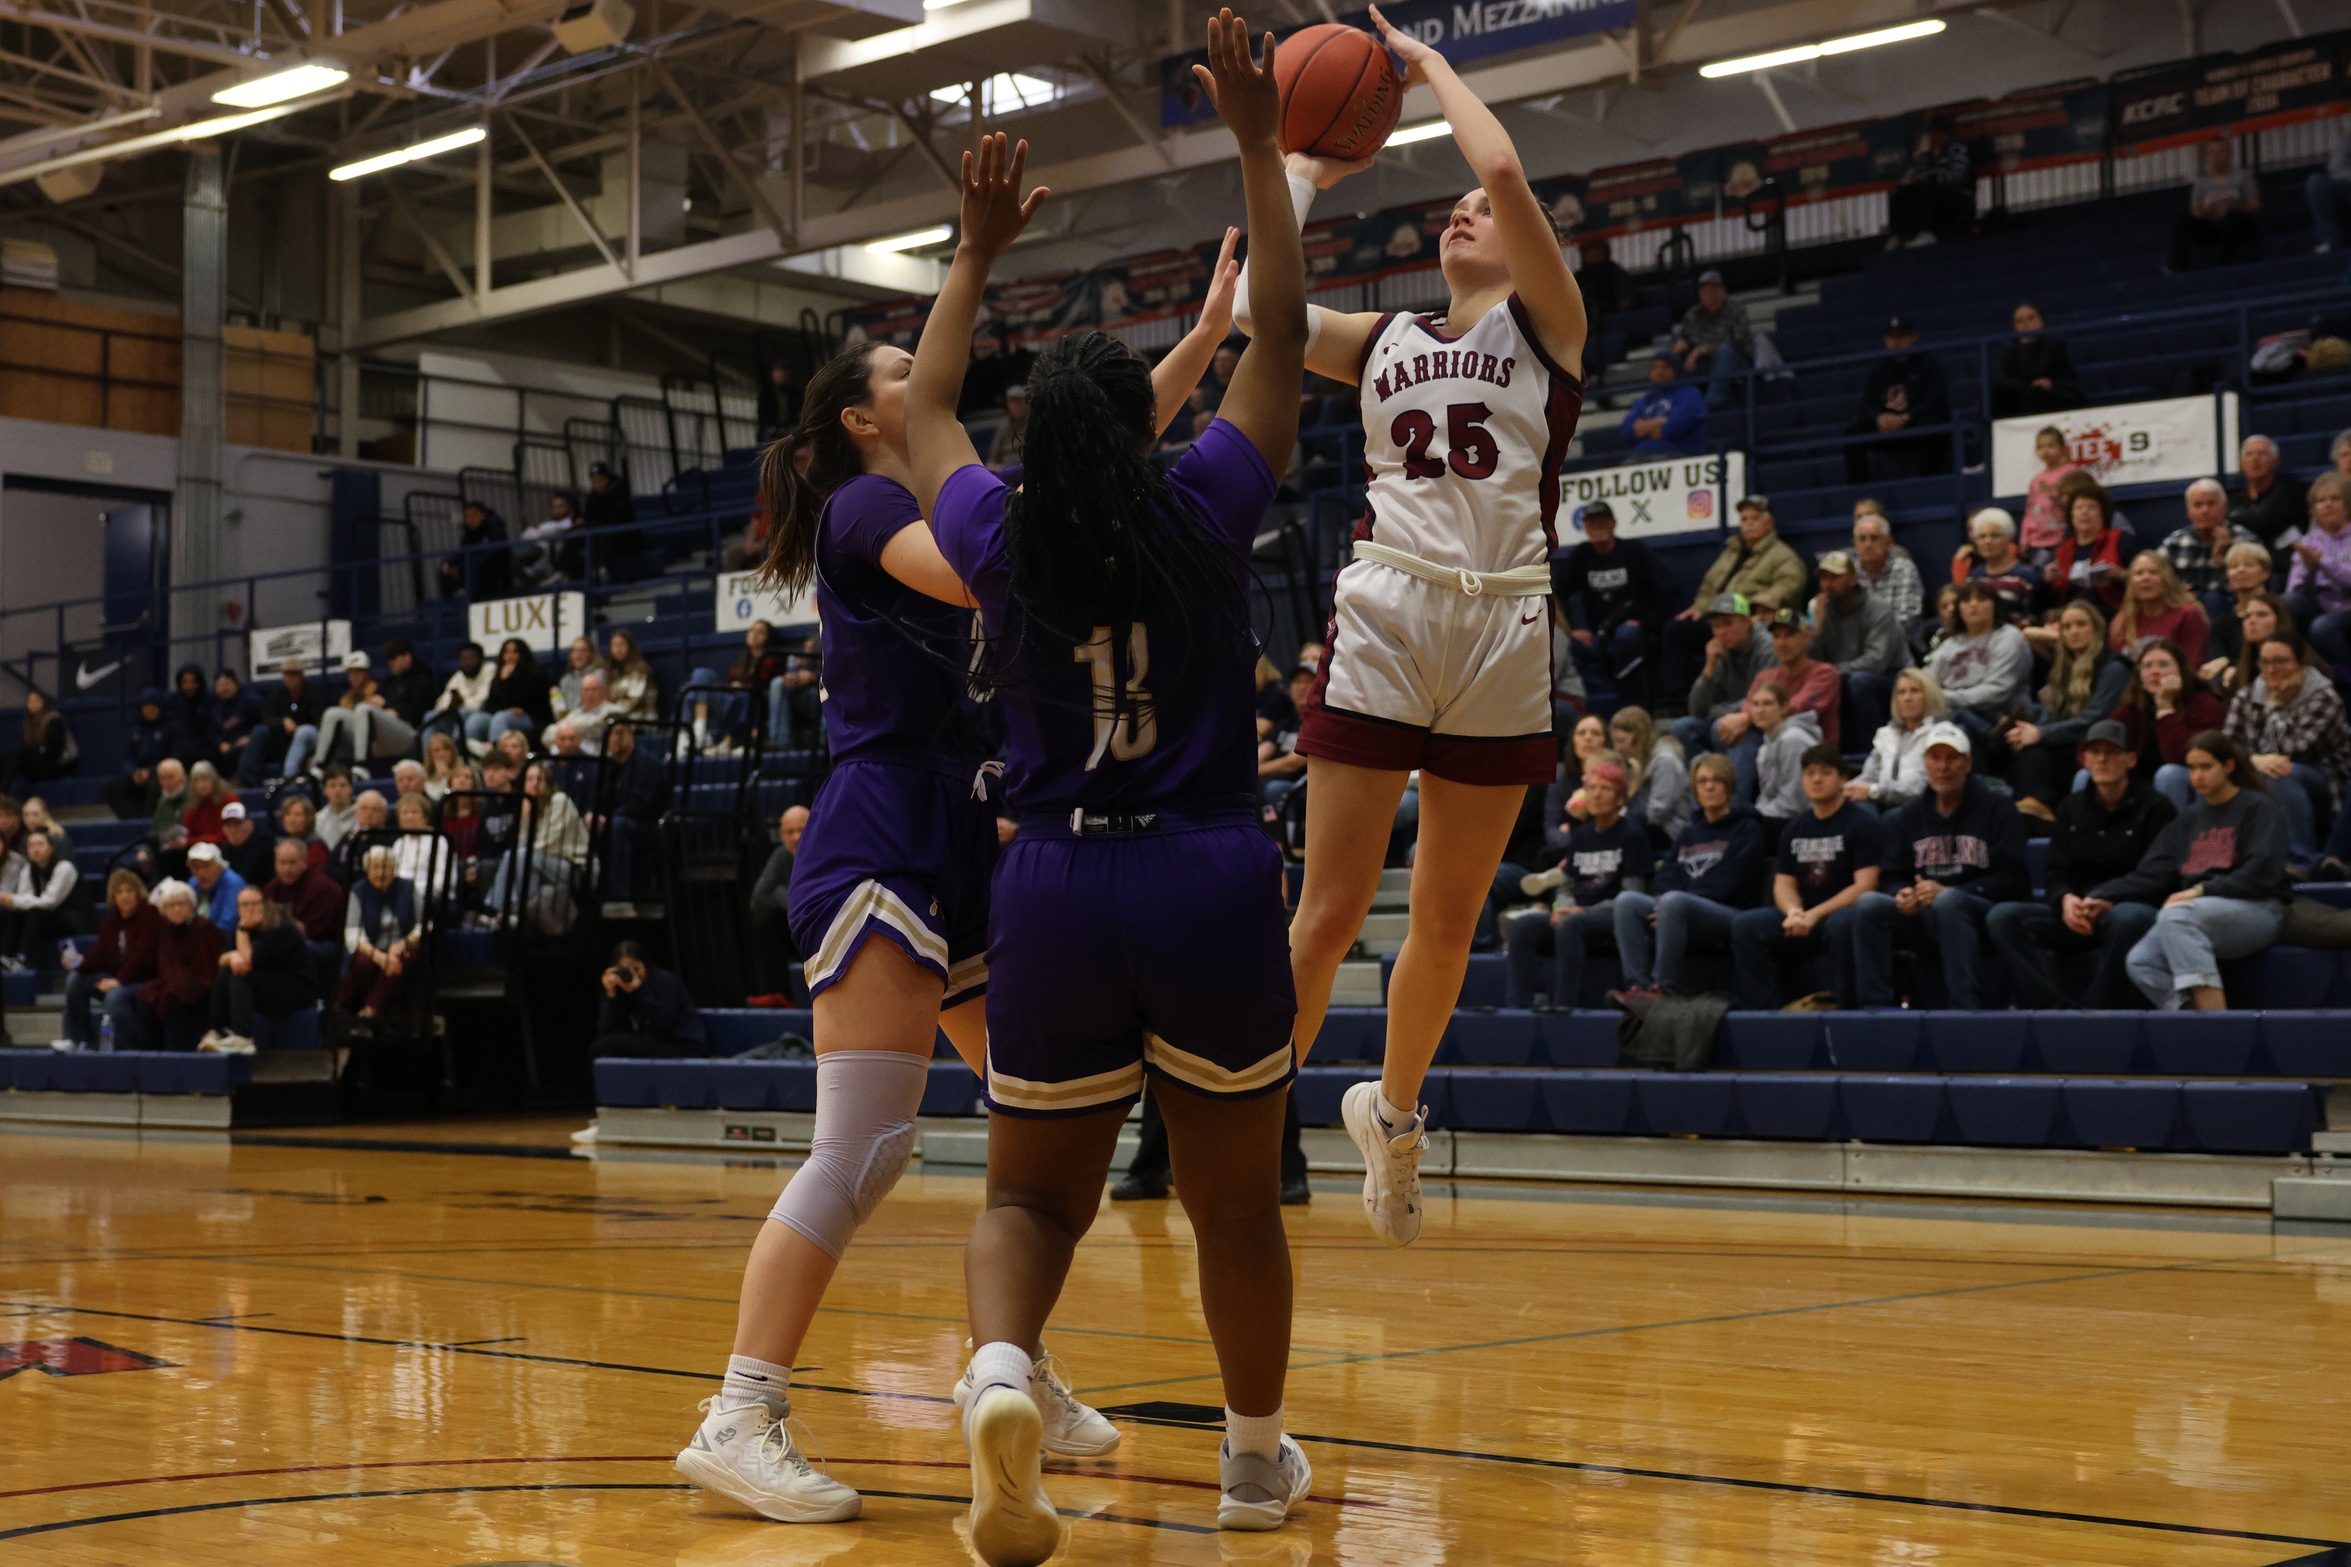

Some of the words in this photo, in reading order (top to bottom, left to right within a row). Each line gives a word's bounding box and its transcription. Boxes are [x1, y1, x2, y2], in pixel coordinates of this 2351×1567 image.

[1452, 0, 1624, 40] MEZZANI
[1334, 66, 1394, 151] SPALDING
[1374, 351, 1516, 402] WARRIORS
[1391, 402, 1501, 480] 25
[1561, 467, 1672, 503] FOLLOW
[1684, 461, 1727, 487] US
